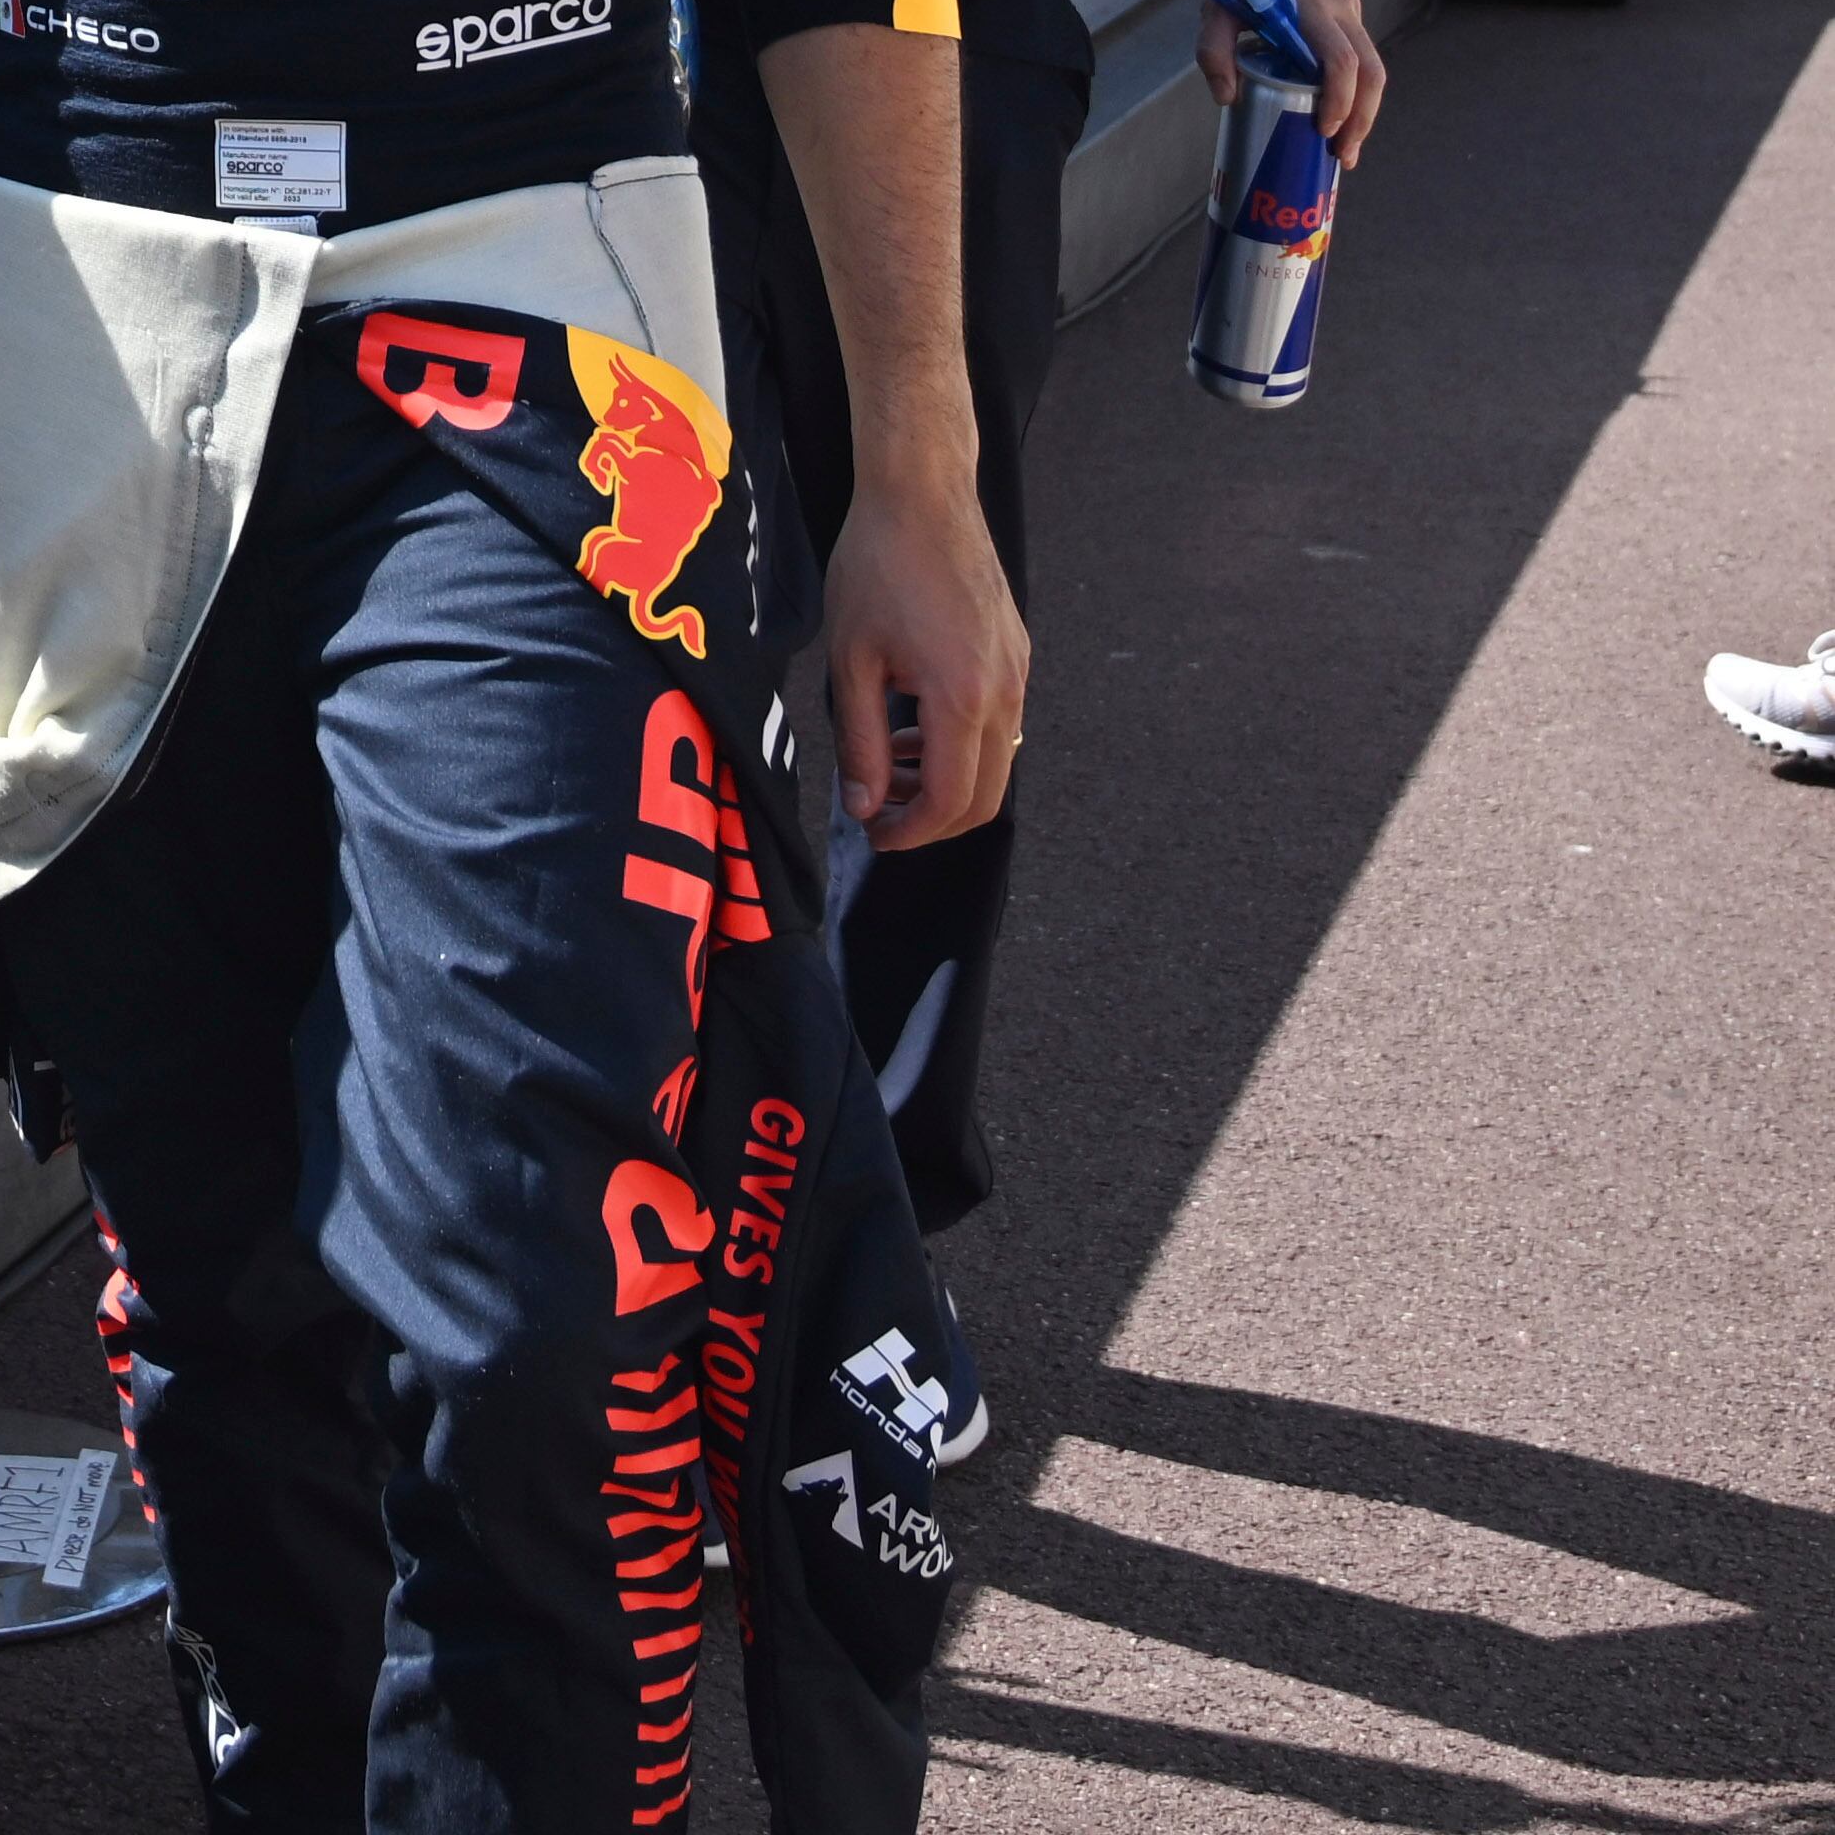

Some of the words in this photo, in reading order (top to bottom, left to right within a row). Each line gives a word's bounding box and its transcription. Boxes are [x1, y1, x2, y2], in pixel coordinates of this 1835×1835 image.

[27, 4, 161, 54] CHECO
[226, 160, 283, 176] sparco
[1248, 187, 1326, 231] Red
[723, 1097, 806, 1285] GIVES
[701, 1306, 766, 1442] YOU
[829, 1368, 924, 1461] Honda
[70, 1488, 98, 1513] NOT
[68, 1518, 91, 1531] do
[54, 1534, 87, 1573] Please
